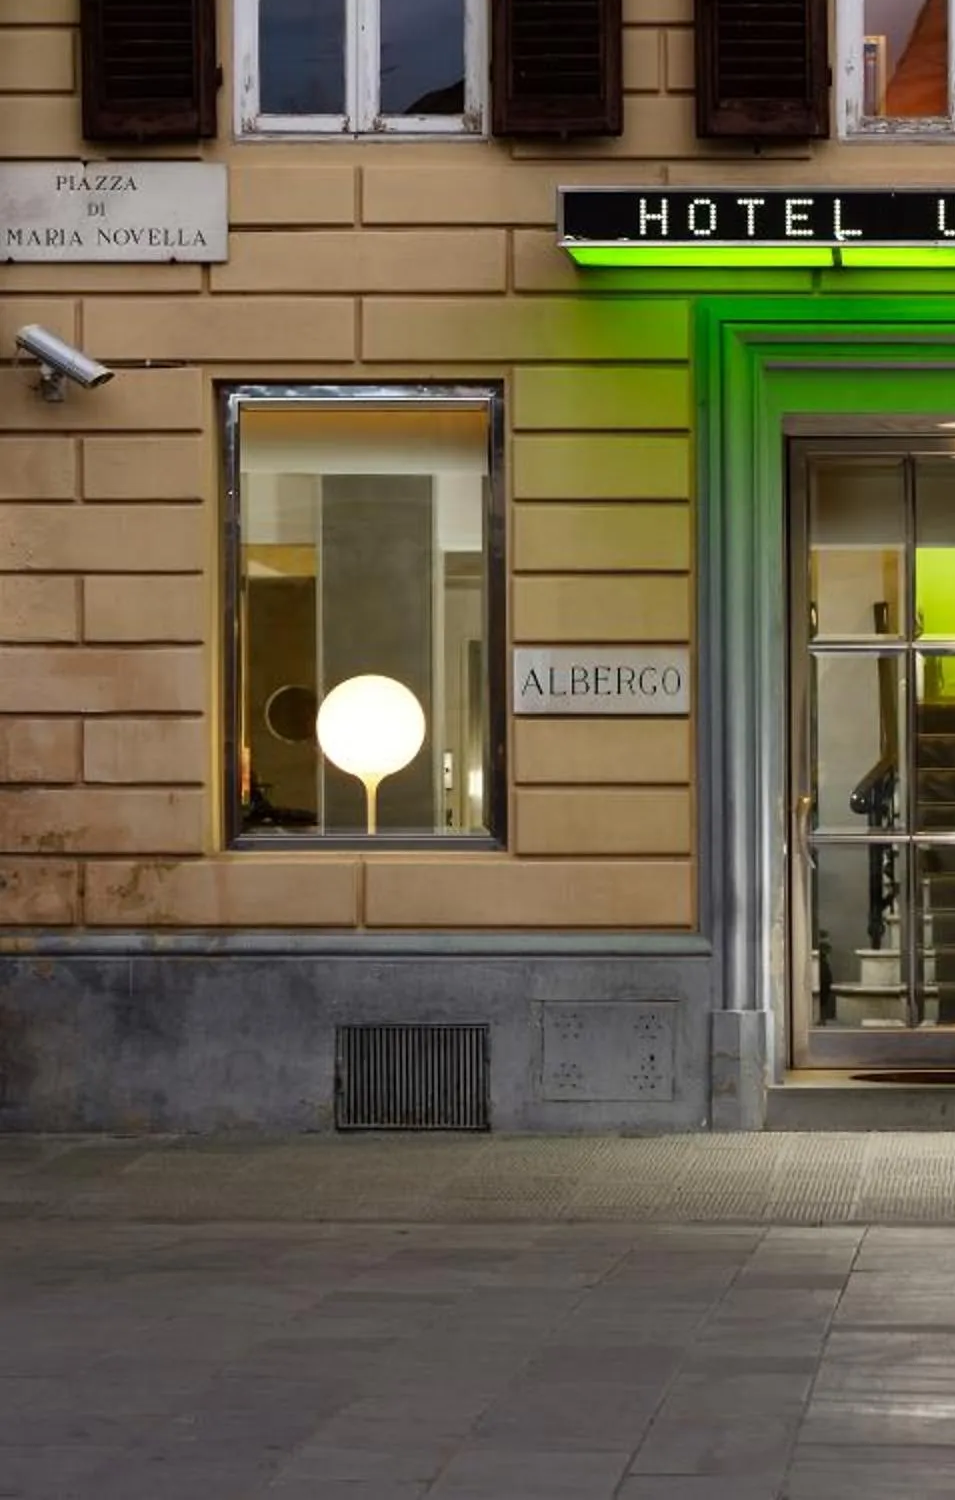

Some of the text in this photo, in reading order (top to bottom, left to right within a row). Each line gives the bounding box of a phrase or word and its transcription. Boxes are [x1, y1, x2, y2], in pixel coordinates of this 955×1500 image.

[55, 175, 138, 191] PIAZZA
[87, 202, 106, 217] DI
[639, 198, 863, 236] HOTEL
[6, 228, 207, 247] MARIA NOVELLA
[521, 666, 681, 696] ALBERGO
